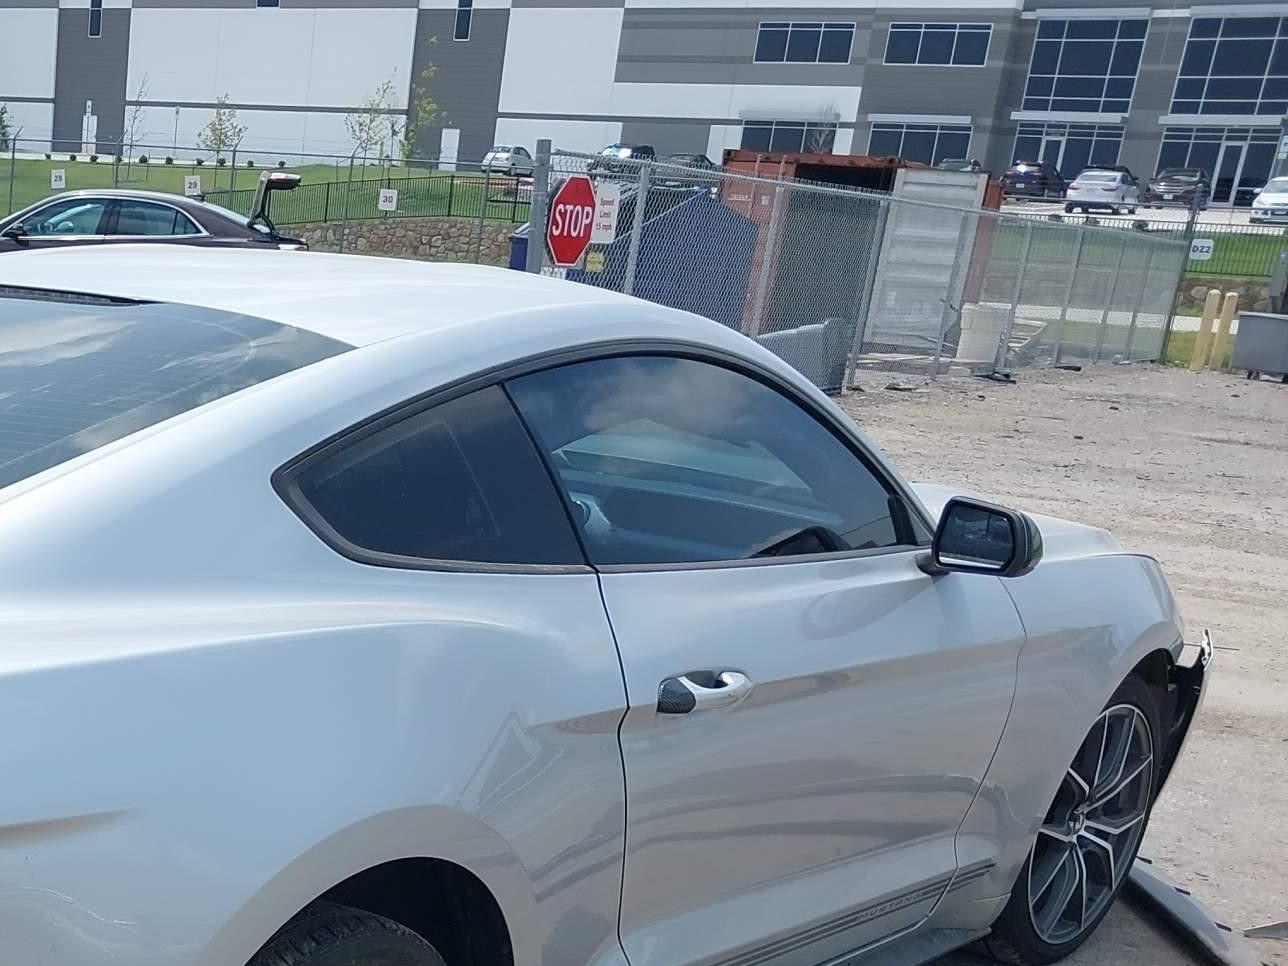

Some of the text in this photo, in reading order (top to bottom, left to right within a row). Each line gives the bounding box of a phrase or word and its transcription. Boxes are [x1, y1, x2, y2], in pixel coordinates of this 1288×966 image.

[382, 195, 394, 203] 30
[552, 203, 593, 238] STOP
[856, 891, 922, 920] MUSTANG
